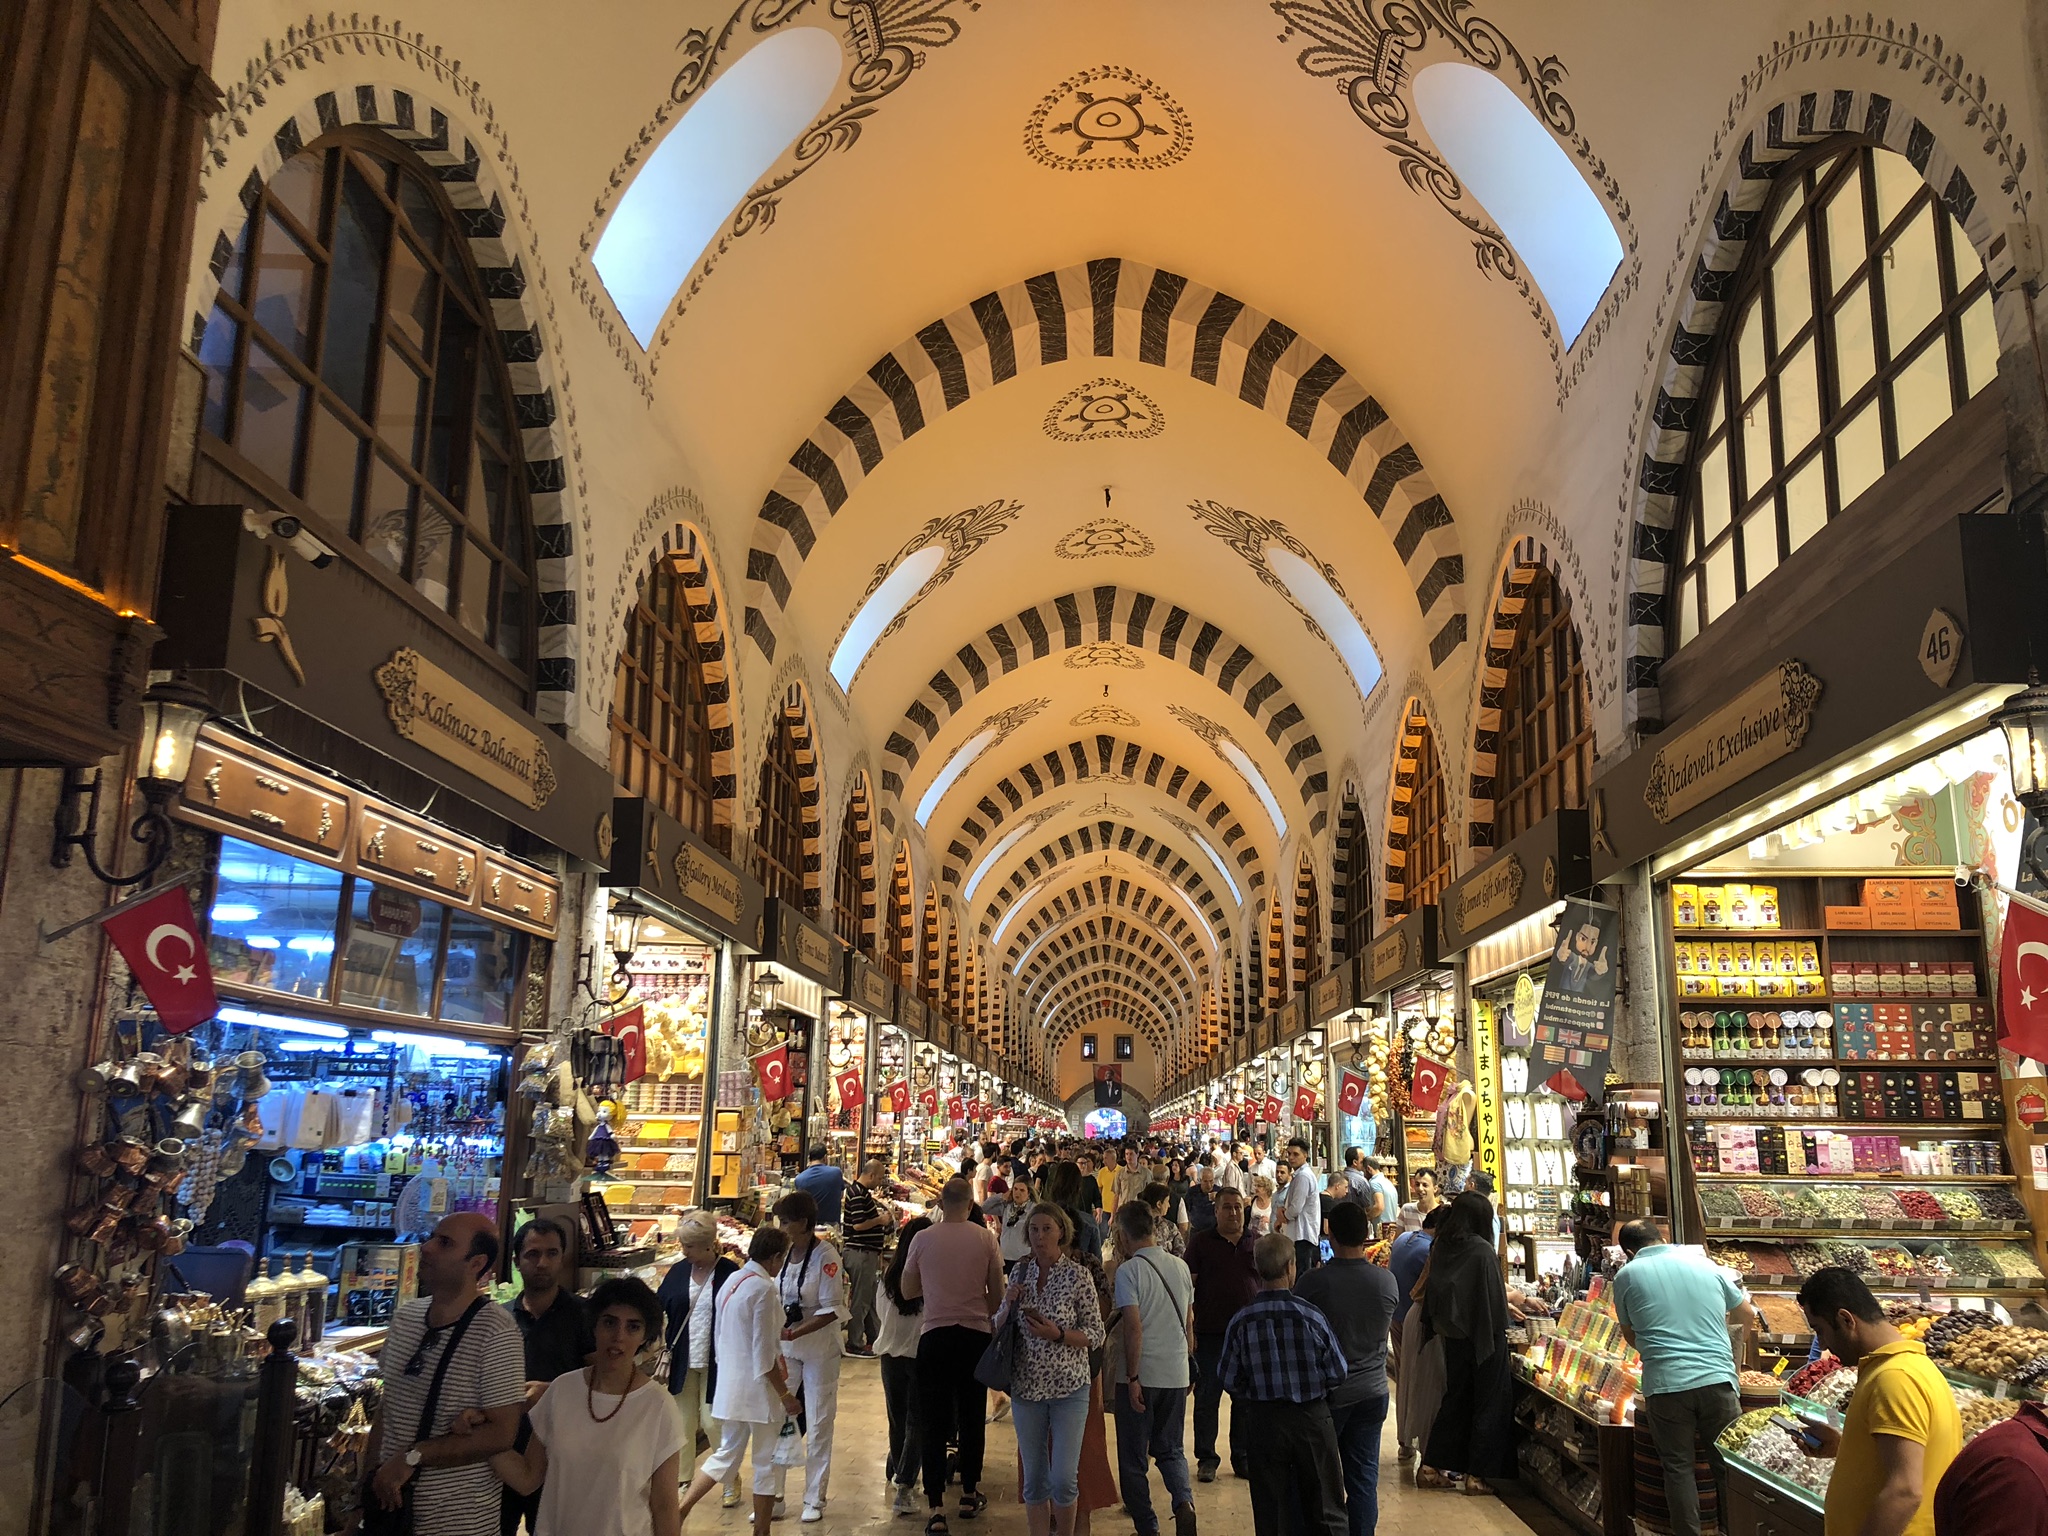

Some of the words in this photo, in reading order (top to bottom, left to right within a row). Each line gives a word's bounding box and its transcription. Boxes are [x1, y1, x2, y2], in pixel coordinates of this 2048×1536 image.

[1926, 626, 1950, 664] 46
[418, 691, 478, 748] Kalmaz
[481, 729, 532, 780] Baharat
[1667, 739, 1715, 797] Özdeveli
[1716, 706, 1780, 767] Exclusive
[690, 860, 712, 895] Gallery
[1482, 878, 1493, 908] Gift
[1494, 873, 1509, 899] Shop
[1545, 866, 1553, 886] 48
